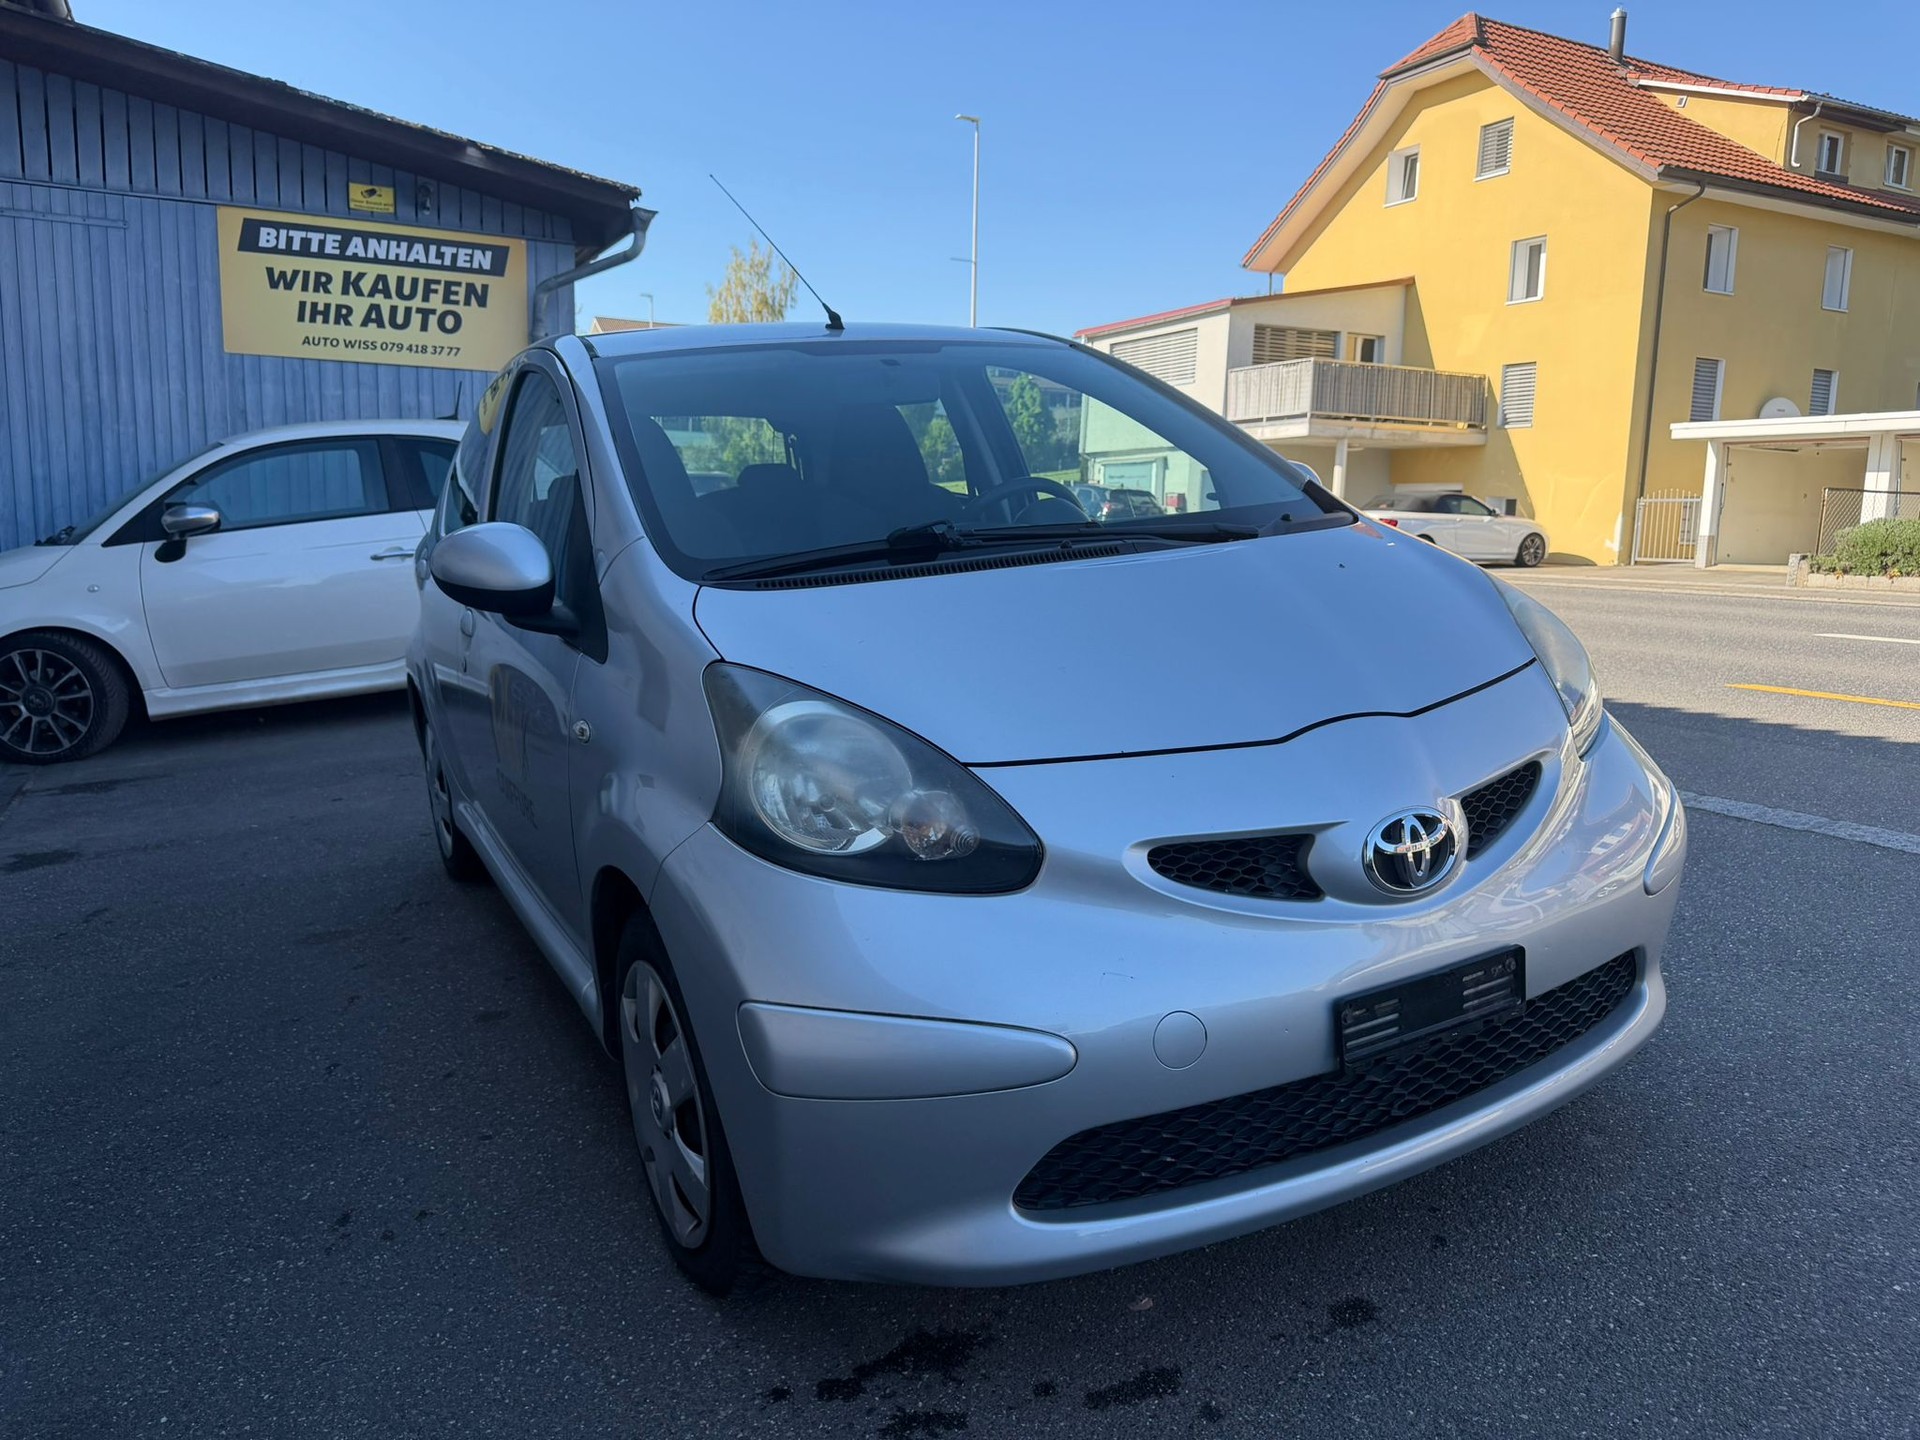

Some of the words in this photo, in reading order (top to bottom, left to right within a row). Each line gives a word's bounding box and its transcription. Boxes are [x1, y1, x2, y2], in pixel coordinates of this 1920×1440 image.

[259, 227, 341, 255] BITTE
[345, 236, 492, 270] ANHALTEN
[265, 267, 333, 294] WIR
[341, 270, 489, 308] KAUFEN
[297, 300, 354, 327] IHR
[360, 303, 463, 334] AUTO
[302, 335, 340, 348] AUTO
[343, 339, 378, 351] WISS
[380, 341, 404, 353] 079
[406, 344, 428, 354] 418
